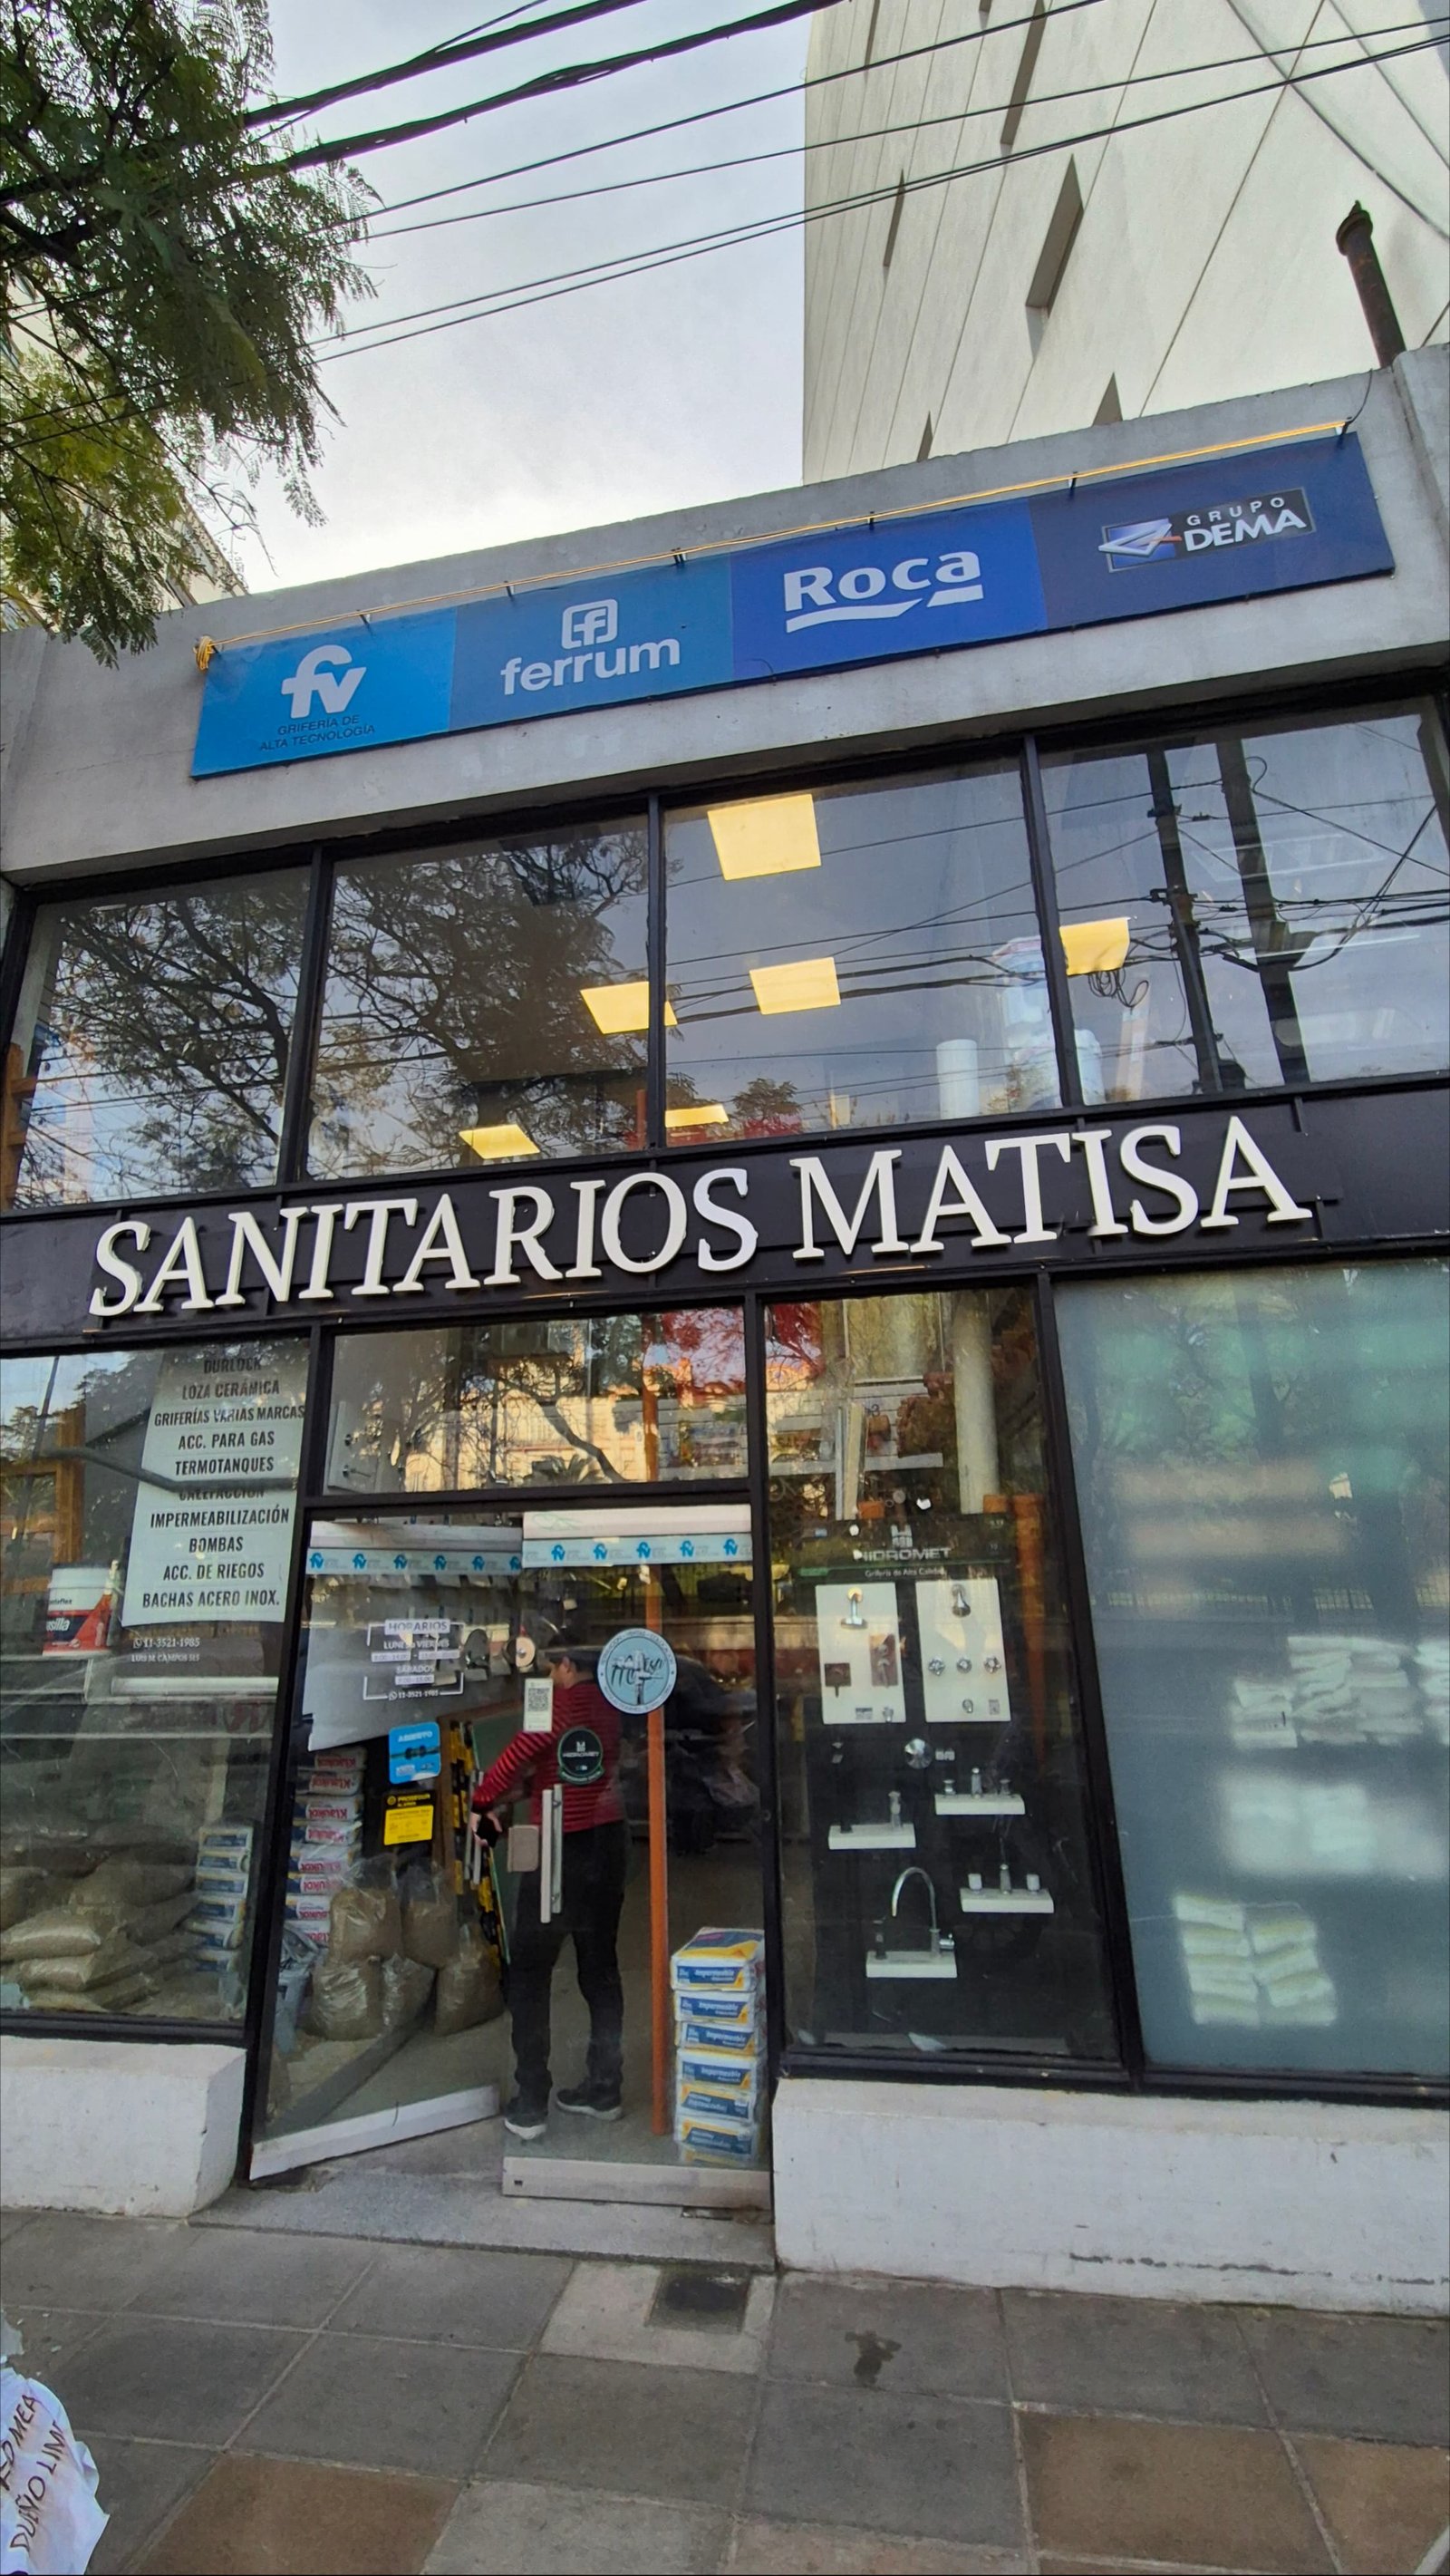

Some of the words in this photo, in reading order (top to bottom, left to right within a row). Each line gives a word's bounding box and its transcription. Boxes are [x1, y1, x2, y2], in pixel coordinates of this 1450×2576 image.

[1186, 497, 1285, 526] GRUPO
[1184, 508, 1307, 551] DEMA
[784, 551, 981, 612] Roca
[500, 638, 680, 695] ferrum
[342, 714, 360, 725] DE
[260, 739, 288, 751] ALTA
[88, 1168, 759, 1317] SANITARIOS
[789, 1116, 1314, 1259] MATISA
[182, 1384, 210, 1399] LOZA
[215, 1379, 280, 1398] CERÁMICA
[154, 1408, 209, 1427] GRIFERÍAS
[214, 1409, 254, 1423] VARIAS
[256, 1405, 305, 1420] MARCAS
[179, 1435, 207, 1450] ACC.
[211, 1432, 245, 1448] PARA
[250, 1431, 275, 1447] GAS
[175, 1457, 275, 1477] TERMOTANQUES
[150, 1505, 289, 1528] IMPERMEABILIZACIÓN
[189, 1536, 244, 1553] BOMBAS
[163, 1565, 192, 1581] ACC.
[197, 1564, 212, 1580] DE
[217, 1563, 265, 1579] RIEGOS
[142, 1592, 193, 1608] BACHAS
[198, 1591, 240, 1607] ACERO
[245, 1590, 280, 1606] INOX.
[389, 1621, 448, 1632] HORARIOS
[309, 1807, 348, 1820] Klaukol
[10, 2475, 46, 2552] DUEÑO
